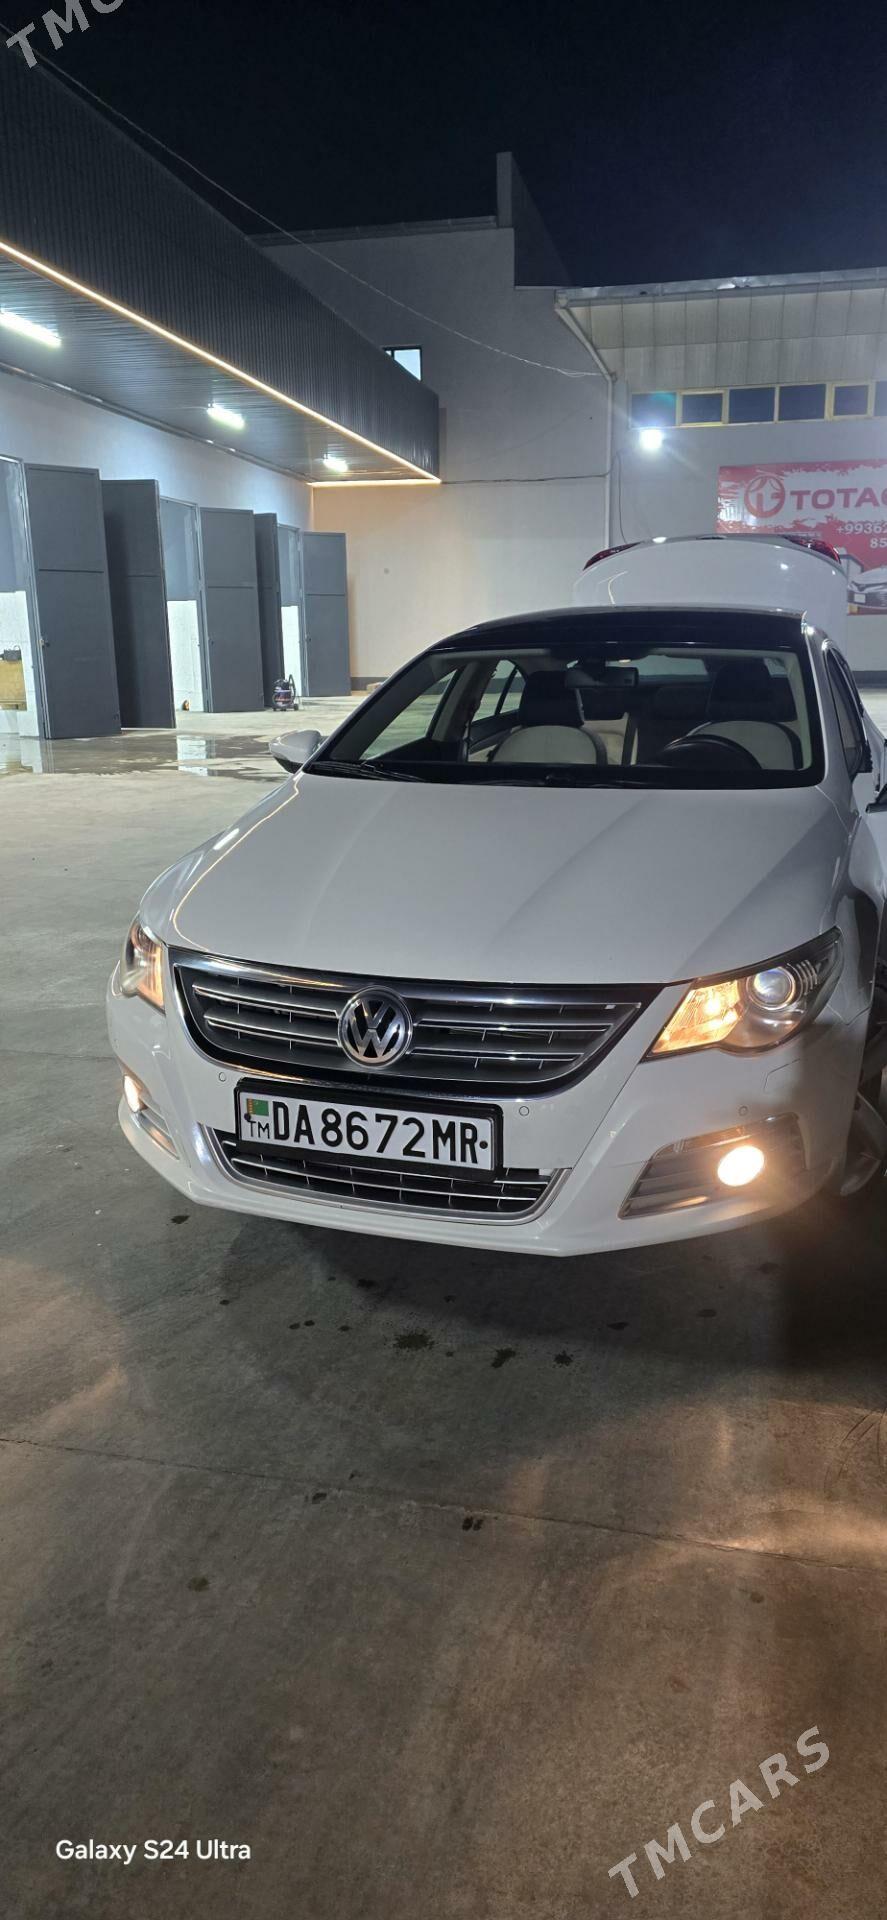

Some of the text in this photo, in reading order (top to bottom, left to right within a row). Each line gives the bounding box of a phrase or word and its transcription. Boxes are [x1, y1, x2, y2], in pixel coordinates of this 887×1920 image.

[789, 487, 887, 511] TOTA
[247, 1100, 478, 1164] TM DA8672MR
